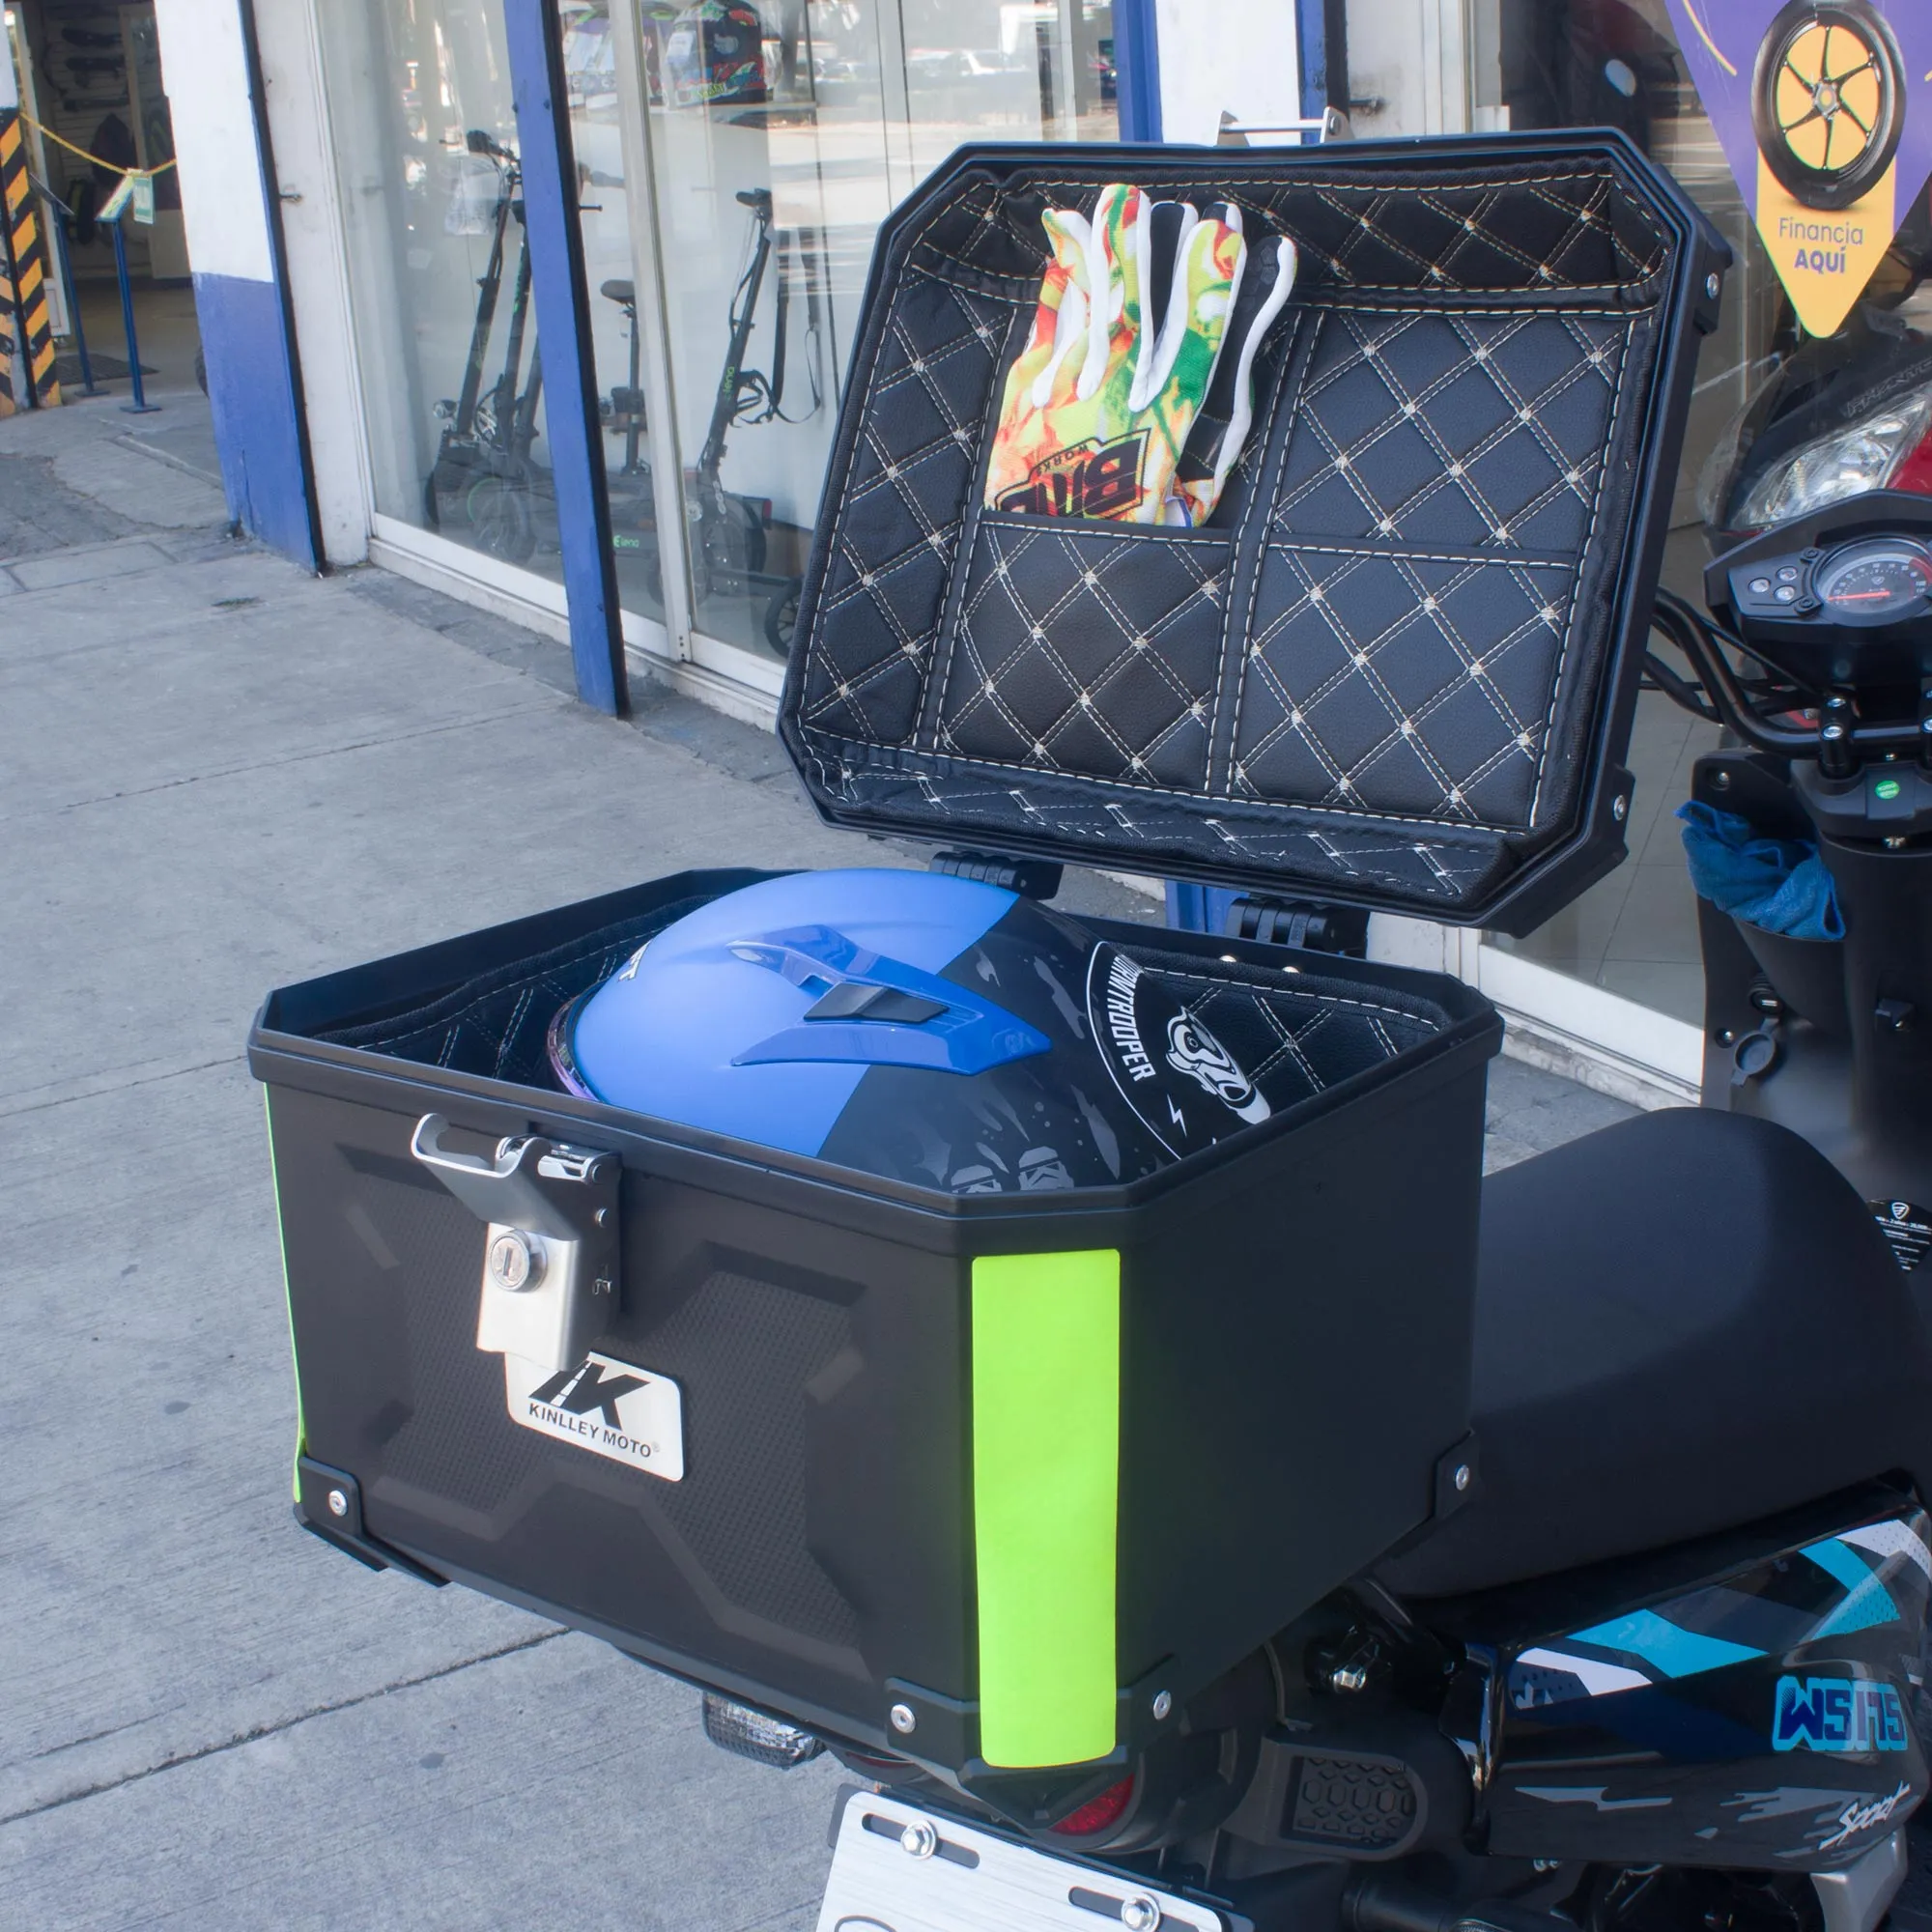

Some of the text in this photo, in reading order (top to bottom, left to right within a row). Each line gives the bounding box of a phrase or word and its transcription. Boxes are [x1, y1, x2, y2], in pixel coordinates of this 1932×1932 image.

[1778, 216, 1863, 244] Financia
[1794, 245, 1847, 274] AQUÍ
[528, 1403, 599, 1439] KINLLEY
